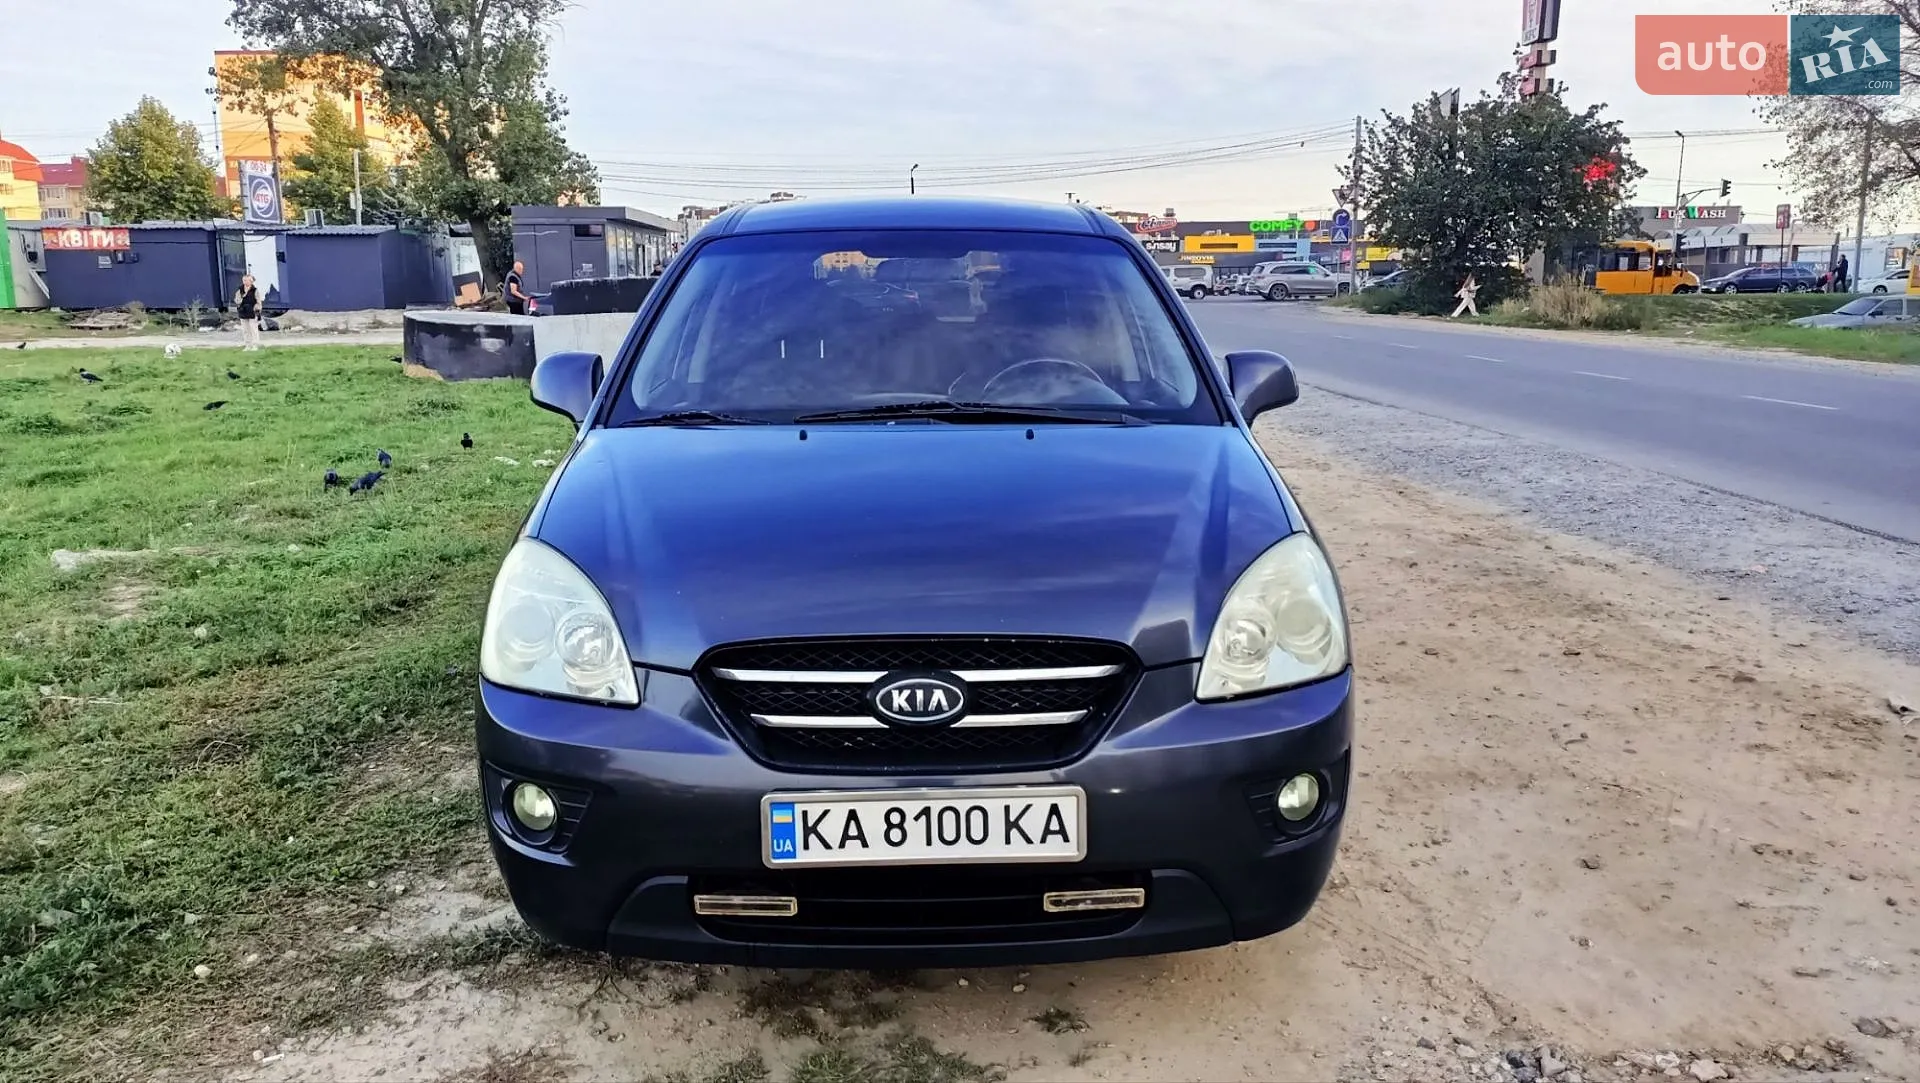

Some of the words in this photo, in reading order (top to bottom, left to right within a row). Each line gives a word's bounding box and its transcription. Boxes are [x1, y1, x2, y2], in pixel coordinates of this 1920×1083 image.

[1249, 219, 1304, 232] COMFY
[57, 229, 115, 248] КВІТИ
[891, 688, 950, 712] KIA
[801, 808, 870, 851] KA
[883, 805, 989, 848] 8100
[1003, 803, 1071, 846] KA
[773, 838, 794, 853] UA
